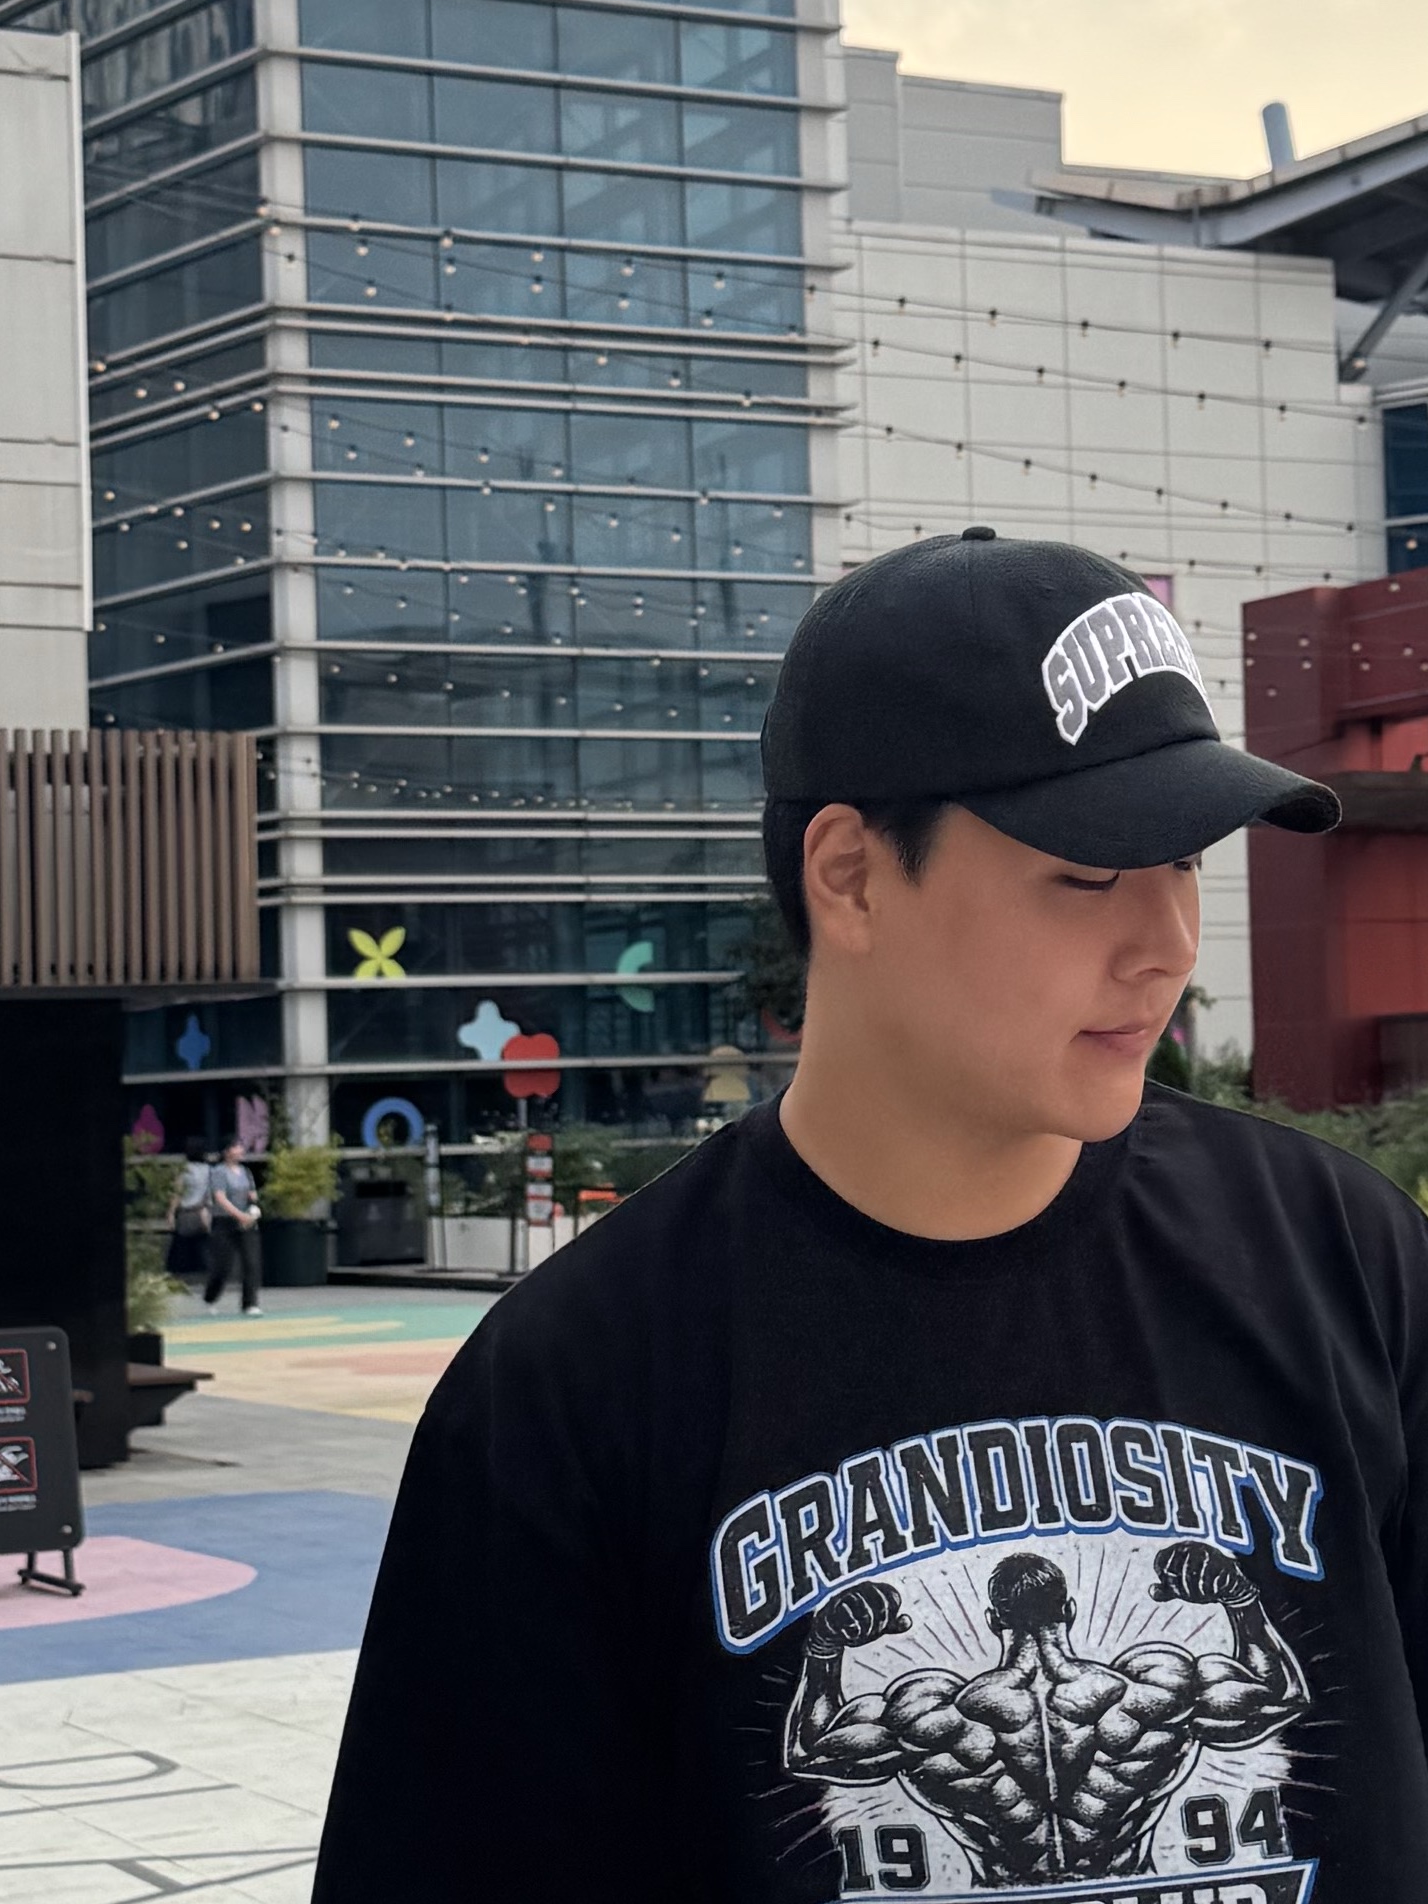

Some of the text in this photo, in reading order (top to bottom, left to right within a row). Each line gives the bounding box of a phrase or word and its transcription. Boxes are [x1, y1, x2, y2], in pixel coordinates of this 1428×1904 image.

[710, 1415, 1326, 1654] GRANDIOSITY
[836, 1788, 1293, 1892] 19 94
